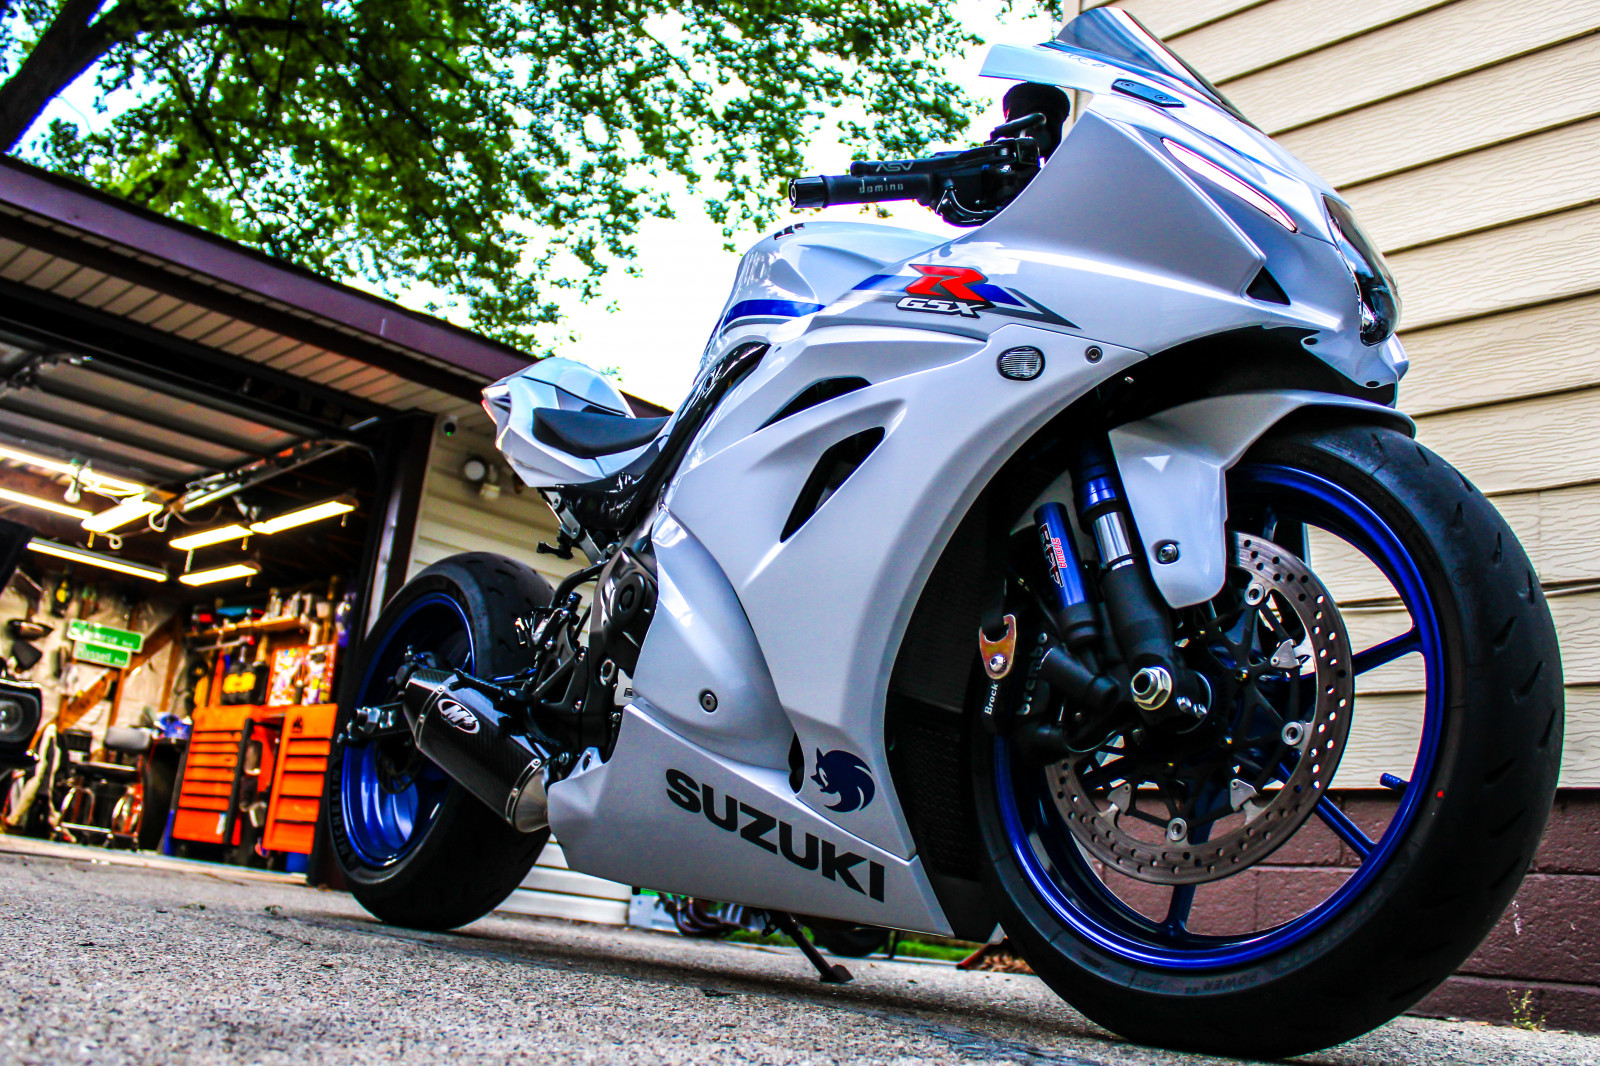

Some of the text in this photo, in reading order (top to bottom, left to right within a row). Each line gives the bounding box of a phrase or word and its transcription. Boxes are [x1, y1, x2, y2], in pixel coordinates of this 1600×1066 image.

[876, 162, 914, 172] ASV
[859, 178, 904, 194] domino
[905, 264, 988, 302] R
[897, 296, 980, 318] GSX
[1051, 537, 1067, 569] SHOWA
[984, 683, 999, 715] Brock
[666, 768, 885, 904] SUZUKI
[1203, 972, 1258, 991] POWER
